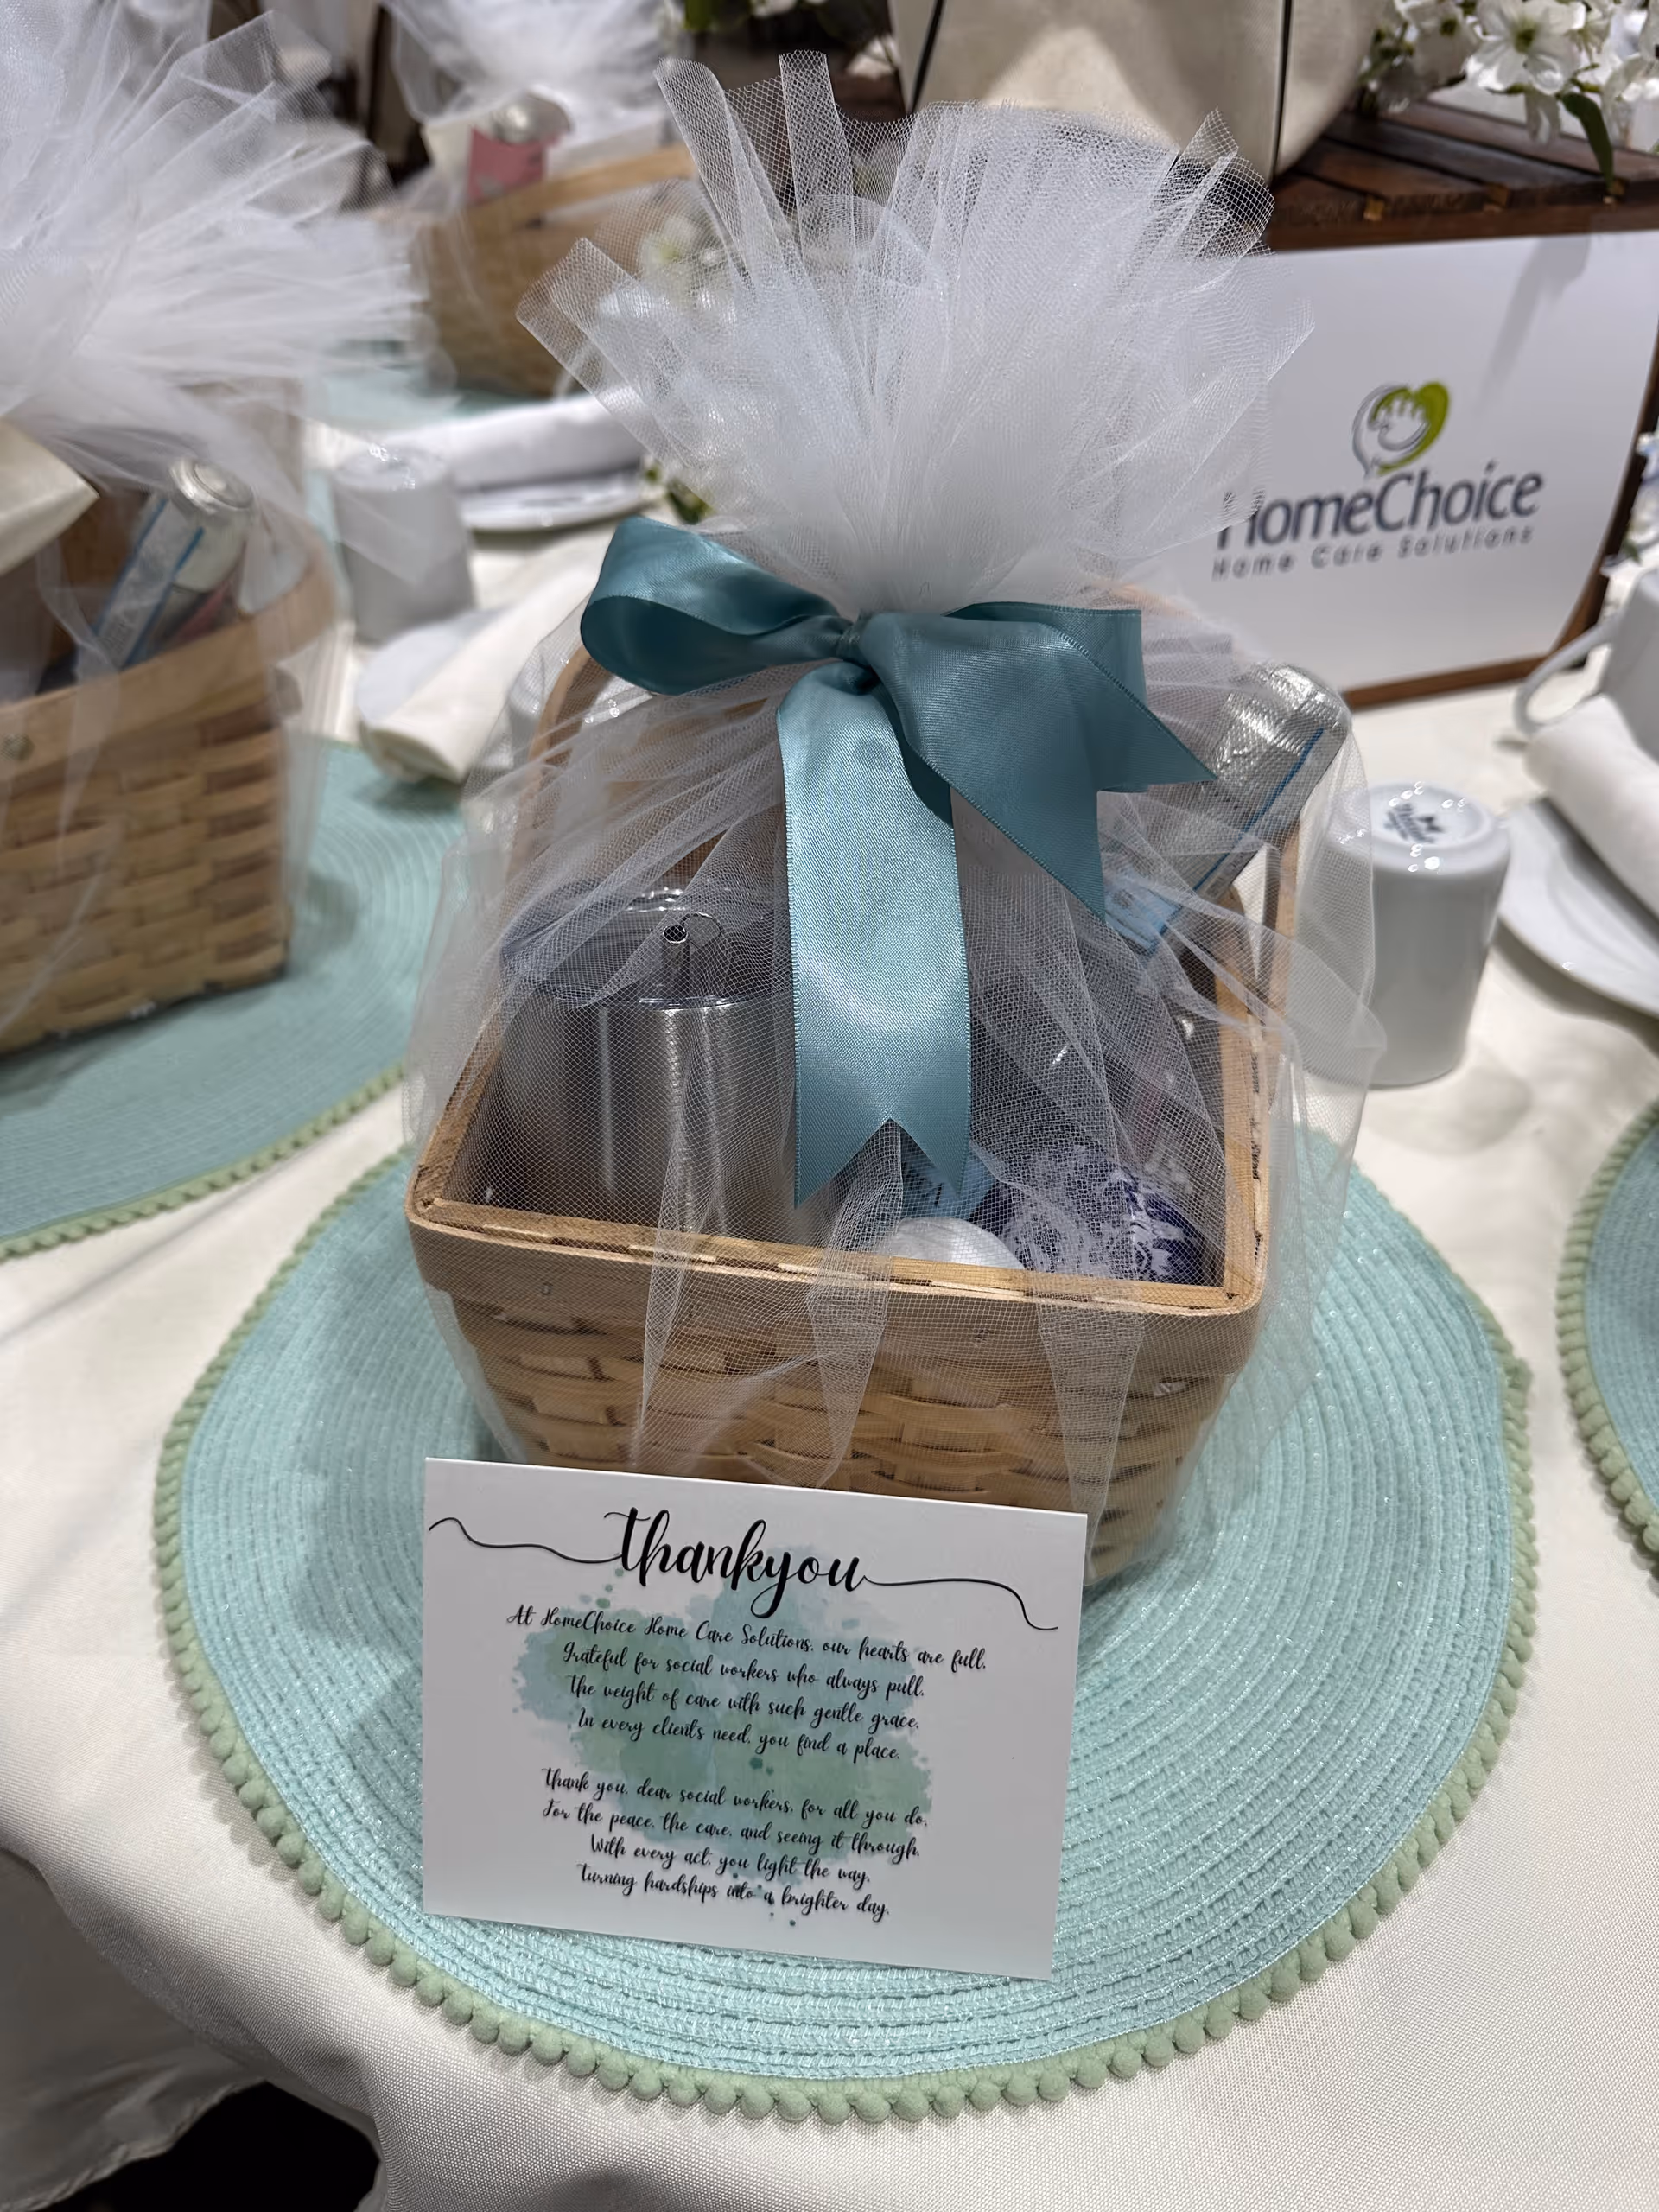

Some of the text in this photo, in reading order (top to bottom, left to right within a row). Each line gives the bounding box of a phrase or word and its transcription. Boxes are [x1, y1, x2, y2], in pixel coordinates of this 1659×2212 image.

[1211, 525, 1535, 582] Home Care Solutions
[506, 1604, 537, 1626] At
[541, 1607, 636, 1634] HomeChoice
[644, 1616, 688, 1637] Home
[696, 1620, 733, 1643] Care
[823, 1643, 851, 1655] our
[859, 1636, 909, 1662] hearts
[917, 1650, 944, 1665] are
[563, 1642, 628, 1671] Grateful
[634, 1652, 659, 1675] for
[666, 1655, 713, 1675] social
[721, 1659, 779, 1682] workers
[787, 1663, 817, 1688] who
[826, 1668, 879, 1700] always
[604, 1681, 657, 1710] weight
[662, 1688, 679, 1710] of
[686, 1694, 720, 1707] care
[728, 1692, 761, 1715] with
[768, 1696, 806, 1720] such
[810, 1702, 863, 1729] gentle
[579, 1707, 594, 1727] In
[601, 1719, 642, 1742] every
[757, 1735, 789, 1755] you
[797, 1732, 832, 1756] find
[836, 1743, 847, 1756] a
[543, 1798, 570, 1820] For
[575, 1802, 602, 1826] the
[663, 1812, 689, 1834] the
[741, 1821, 772, 1841] and
[777, 1831, 823, 1856] seeing
[831, 1830, 847, 1849] it
[637, 1777, 672, 1800] dear
[680, 1786, 726, 1806] social
[801, 1799, 826, 1821] for
[834, 1799, 858, 1820] all
[862, 1810, 896, 1829] you
[591, 1834, 626, 1859] With
[633, 1847, 676, 1870] every
[715, 1857, 749, 1876] you
[757, 1853, 798, 1881] light
[804, 1858, 830, 1879] the
[644, 1870, 719, 1904] hardships
[727, 1881, 755, 1901] into
[763, 1889, 774, 1904] a
[781, 1885, 849, 1916] brighter
